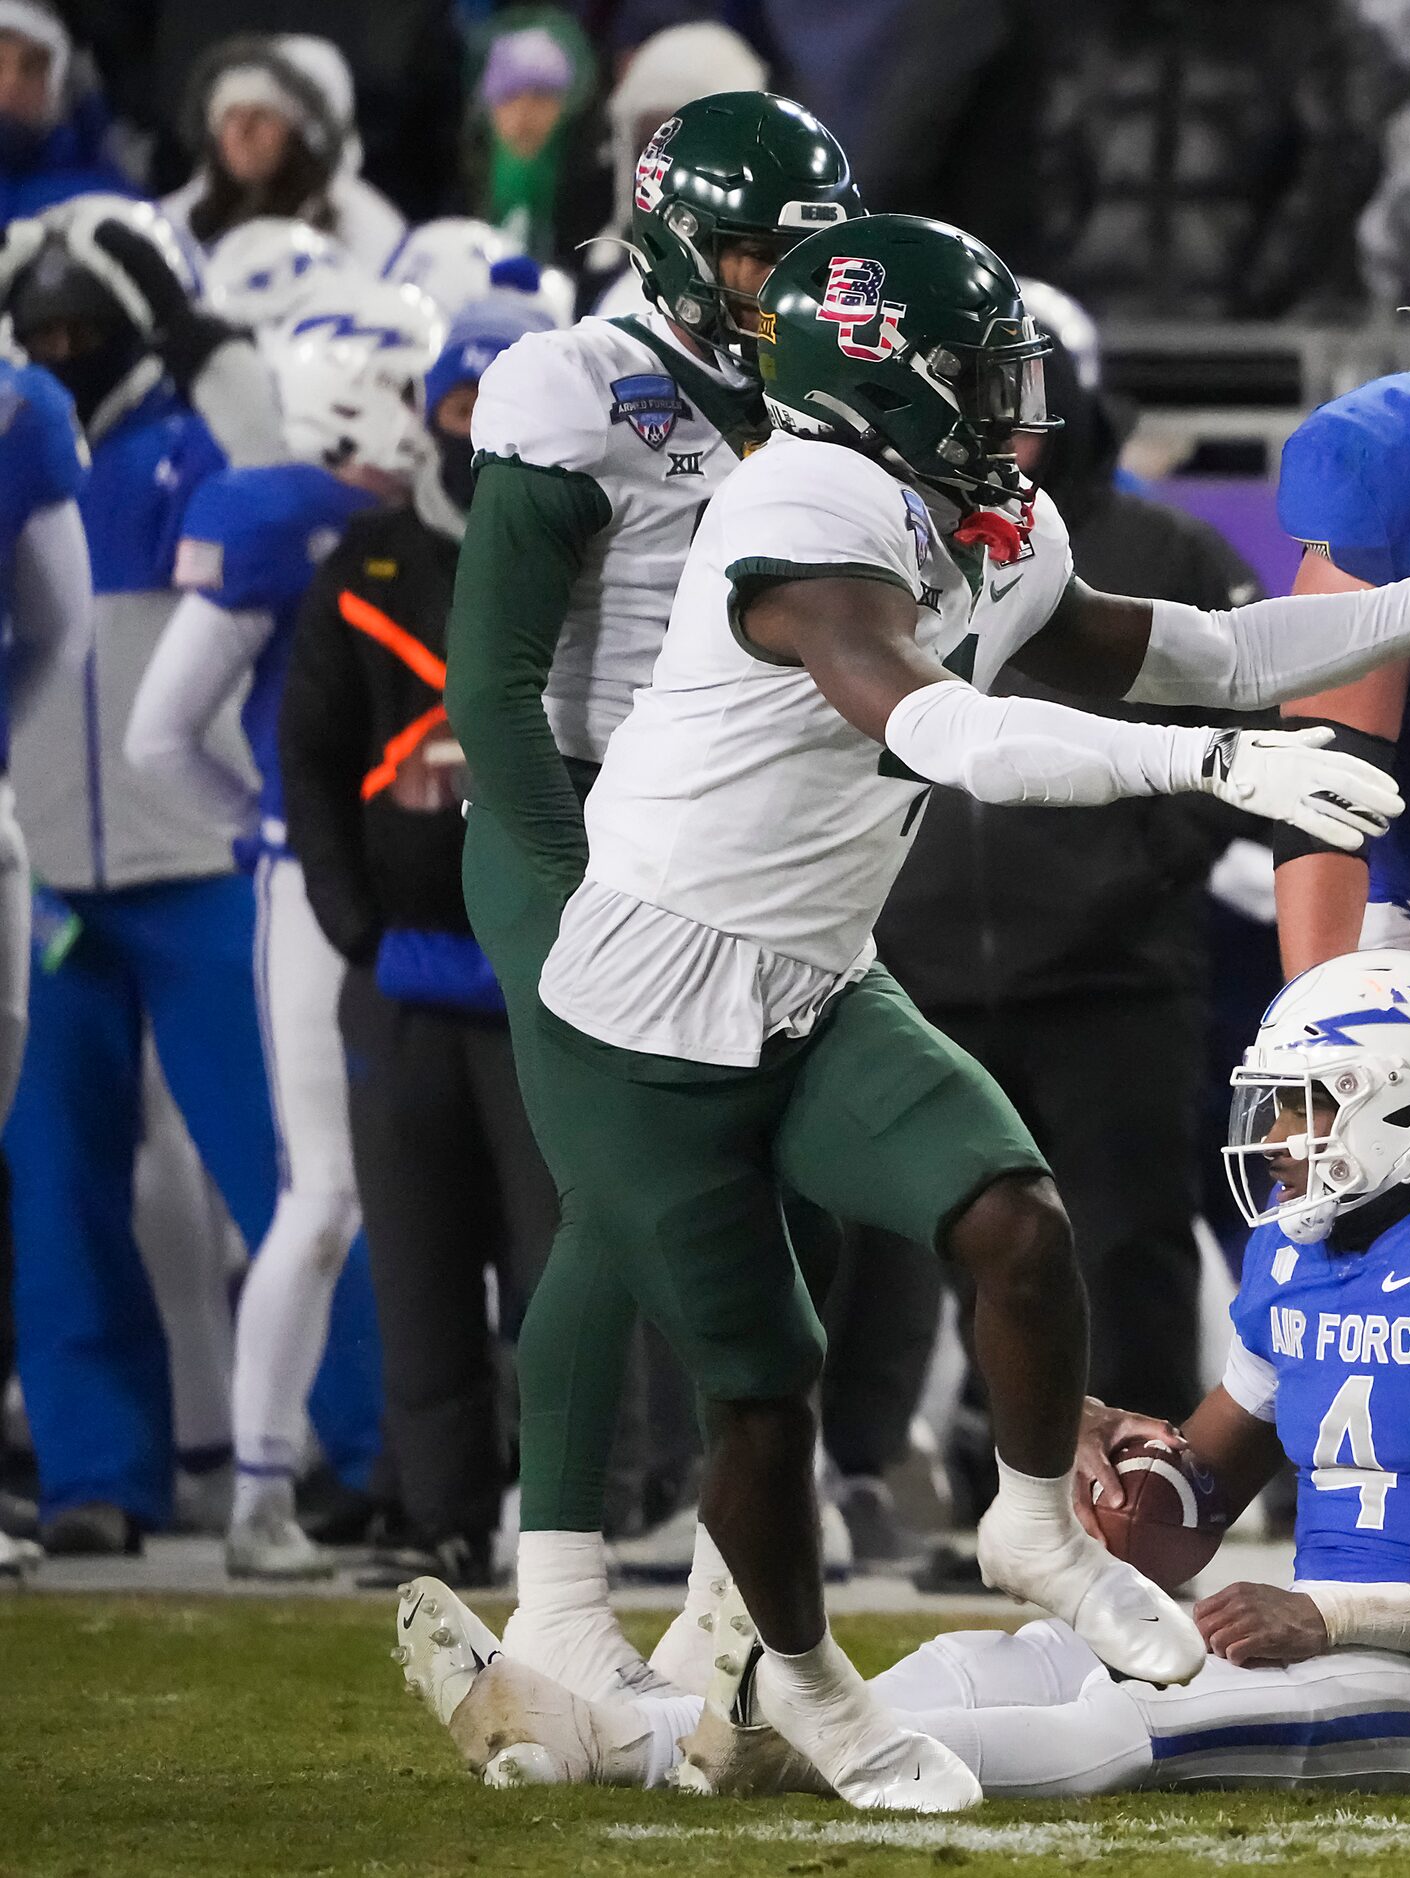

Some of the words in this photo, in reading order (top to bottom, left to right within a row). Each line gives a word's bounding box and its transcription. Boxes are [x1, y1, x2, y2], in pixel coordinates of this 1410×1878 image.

[816, 257, 907, 362] BU
[618, 400, 647, 414] ARMED
[666, 451, 704, 477] XII
[917, 581, 943, 615] XII
[1269, 1305, 1307, 1361] AIR
[1310, 1375, 1398, 1530] 4
